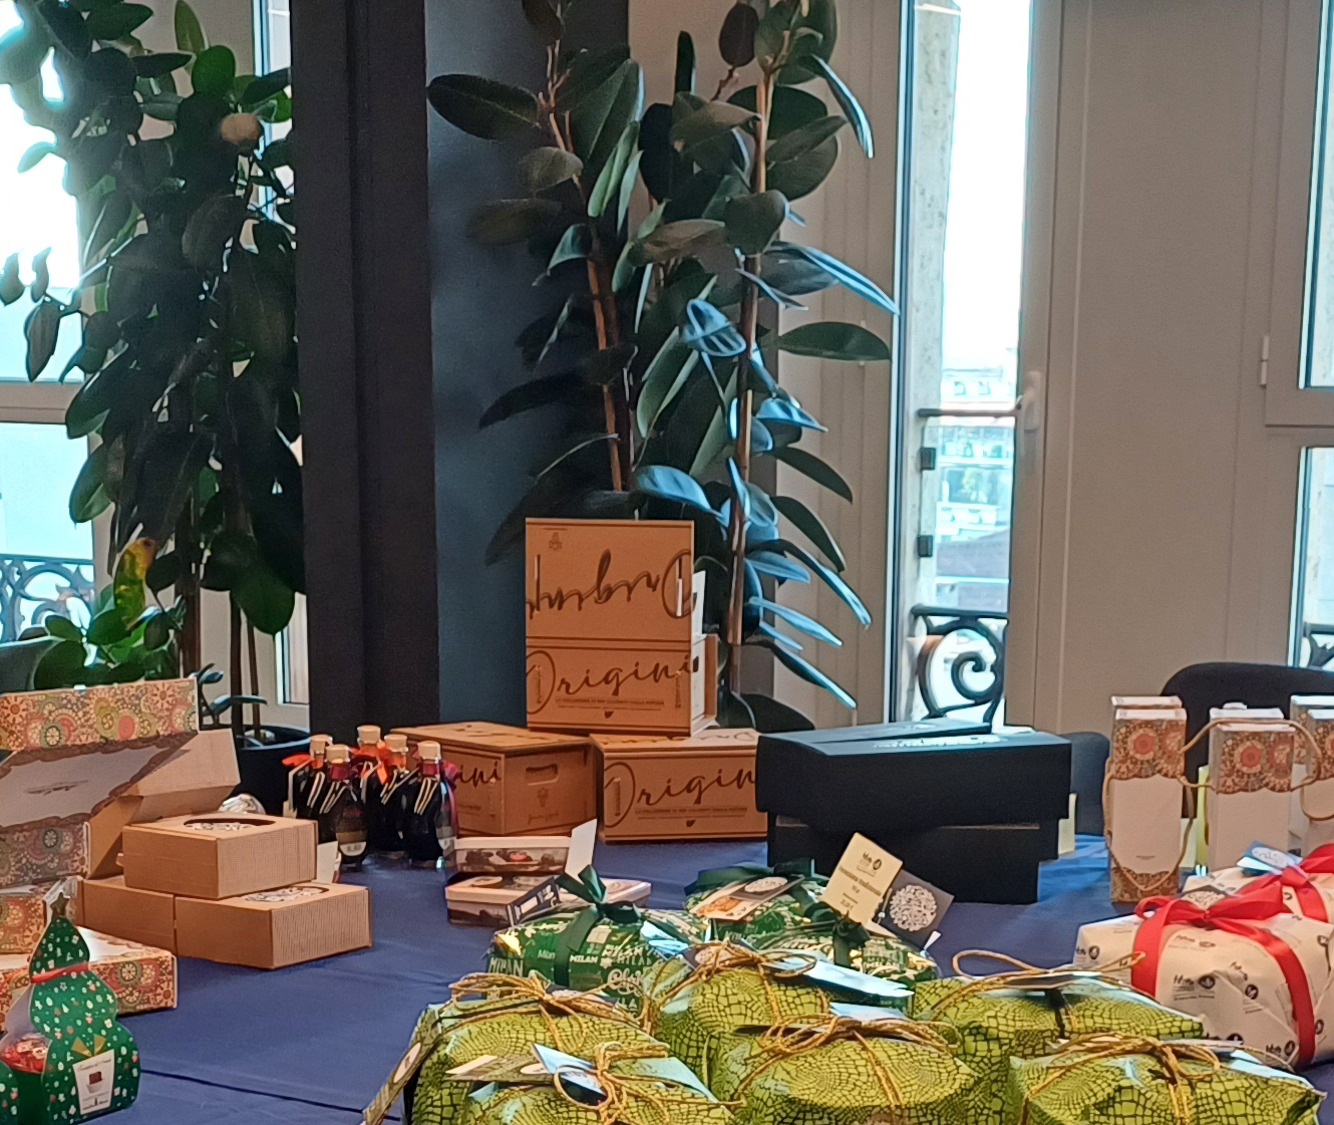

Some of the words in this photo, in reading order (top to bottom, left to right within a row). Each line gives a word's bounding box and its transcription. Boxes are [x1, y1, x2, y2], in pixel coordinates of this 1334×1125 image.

[526, 650, 693, 715] Origini
[605, 762, 757, 828] Origin
[570, 954, 599, 964] MILAN
